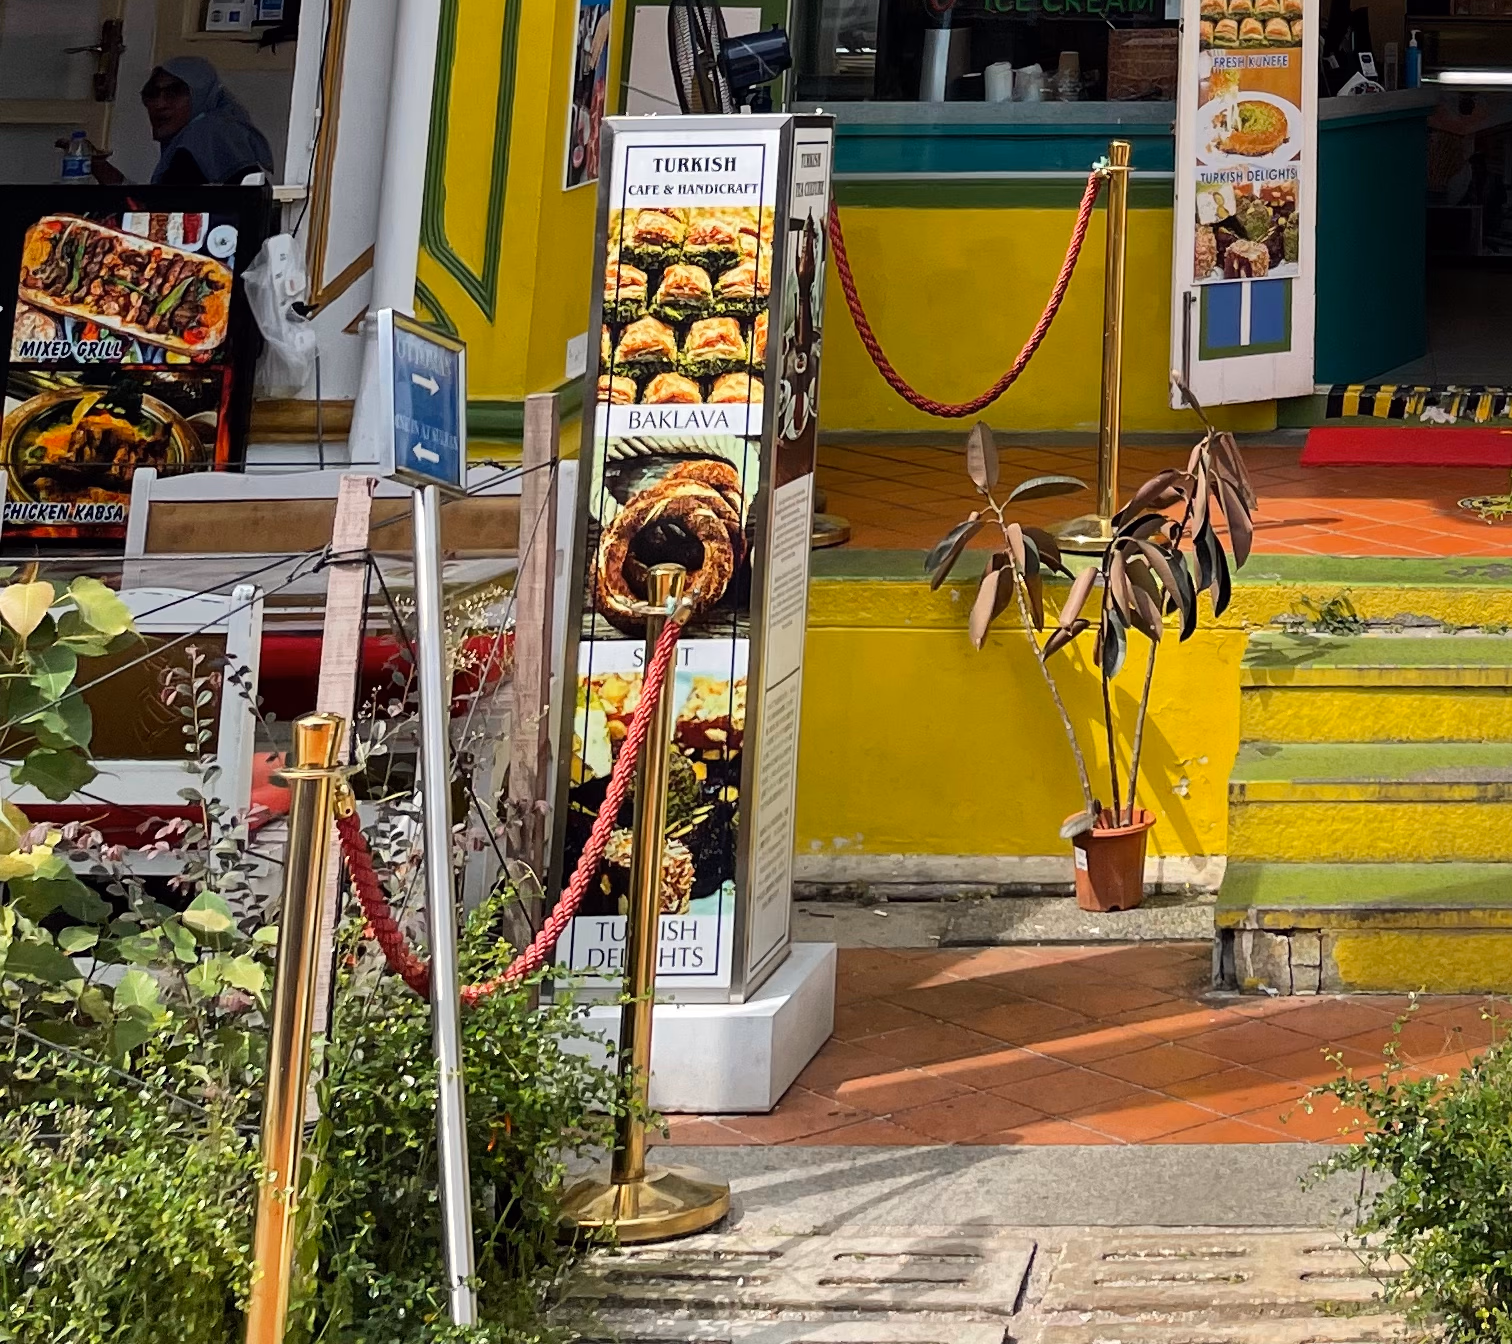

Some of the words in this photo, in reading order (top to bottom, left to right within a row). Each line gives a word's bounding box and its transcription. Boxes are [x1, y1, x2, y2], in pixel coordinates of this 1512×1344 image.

[1213, 54, 1246, 69] FRESH
[1248, 54, 1289, 68] KUNEFE
[653, 156, 737, 173] TURKISH
[1200, 170, 1243, 183] TURKISH
[1246, 167, 1299, 182] DELIGHTS
[628, 183, 660, 196] CAFE
[663, 185, 675, 195] &
[677, 182, 759, 196] HANDICRAFT
[19, 339, 72, 358] MIXED
[76, 339, 123, 358] GRILL
[628, 410, 730, 430] BAKLAVA
[2, 502, 72, 521] CHICKEN
[73, 503, 125, 522] KABSA
[632, 647, 694, 667] SIT
[596, 920, 698, 943] TUISH
